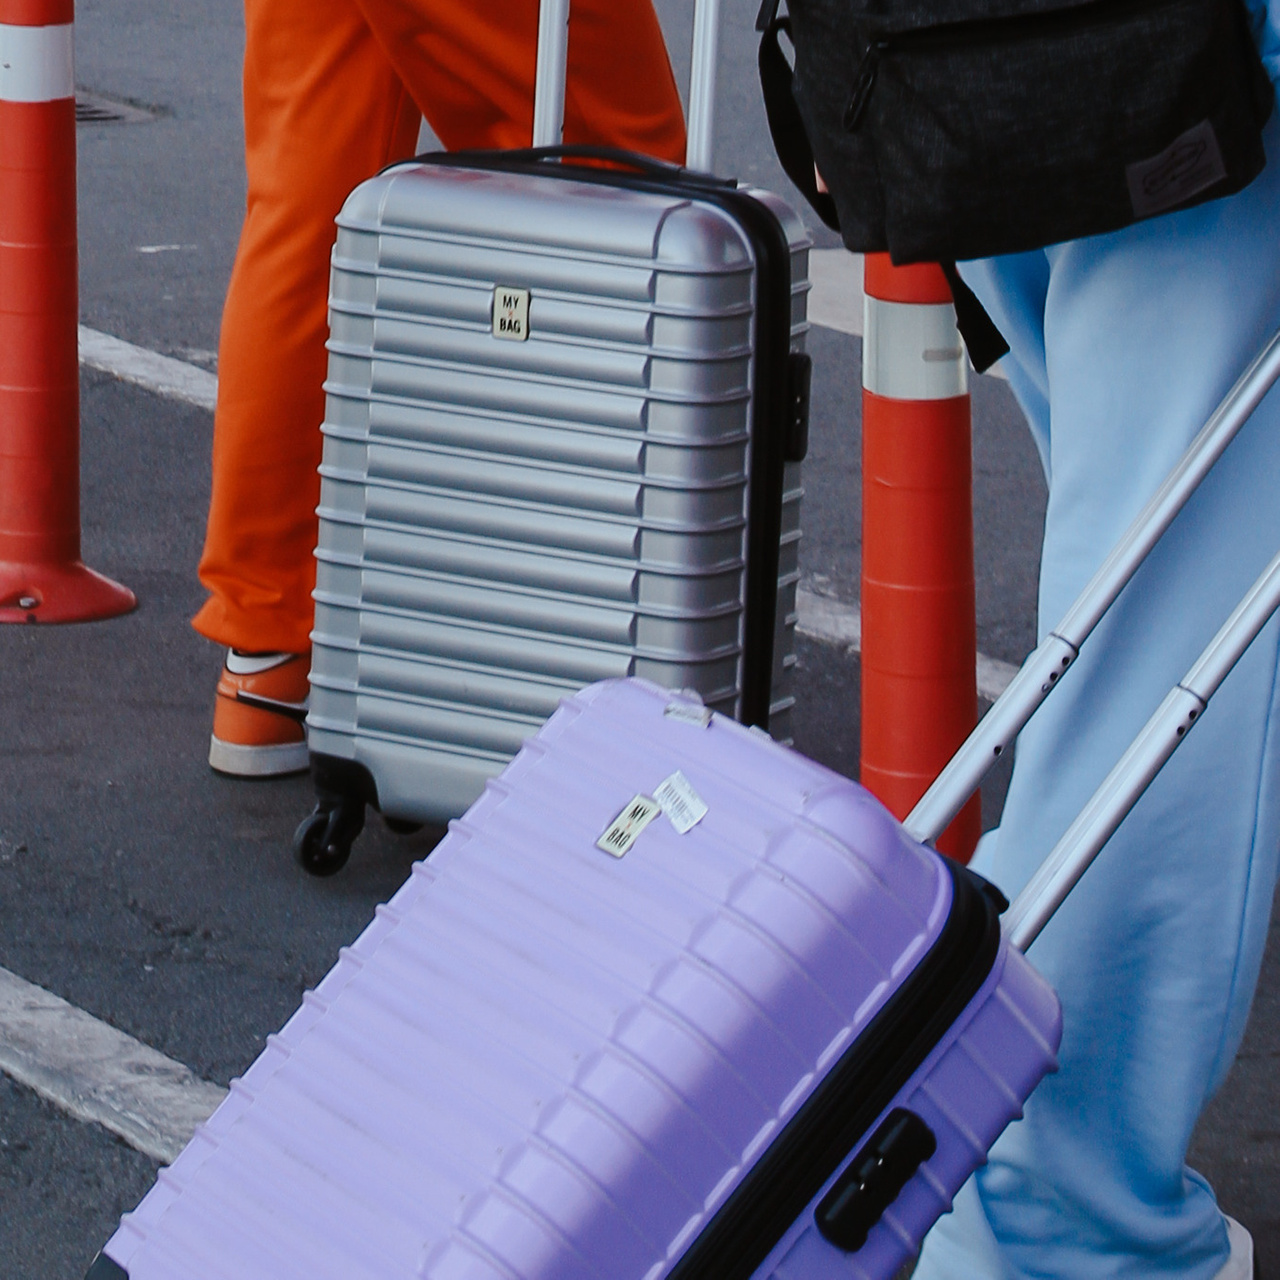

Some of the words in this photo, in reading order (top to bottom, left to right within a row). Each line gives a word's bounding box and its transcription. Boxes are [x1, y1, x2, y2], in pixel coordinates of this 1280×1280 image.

[502, 294, 520, 310] MY
[499, 317, 522, 334] BAG
[627, 804, 651, 824] MY
